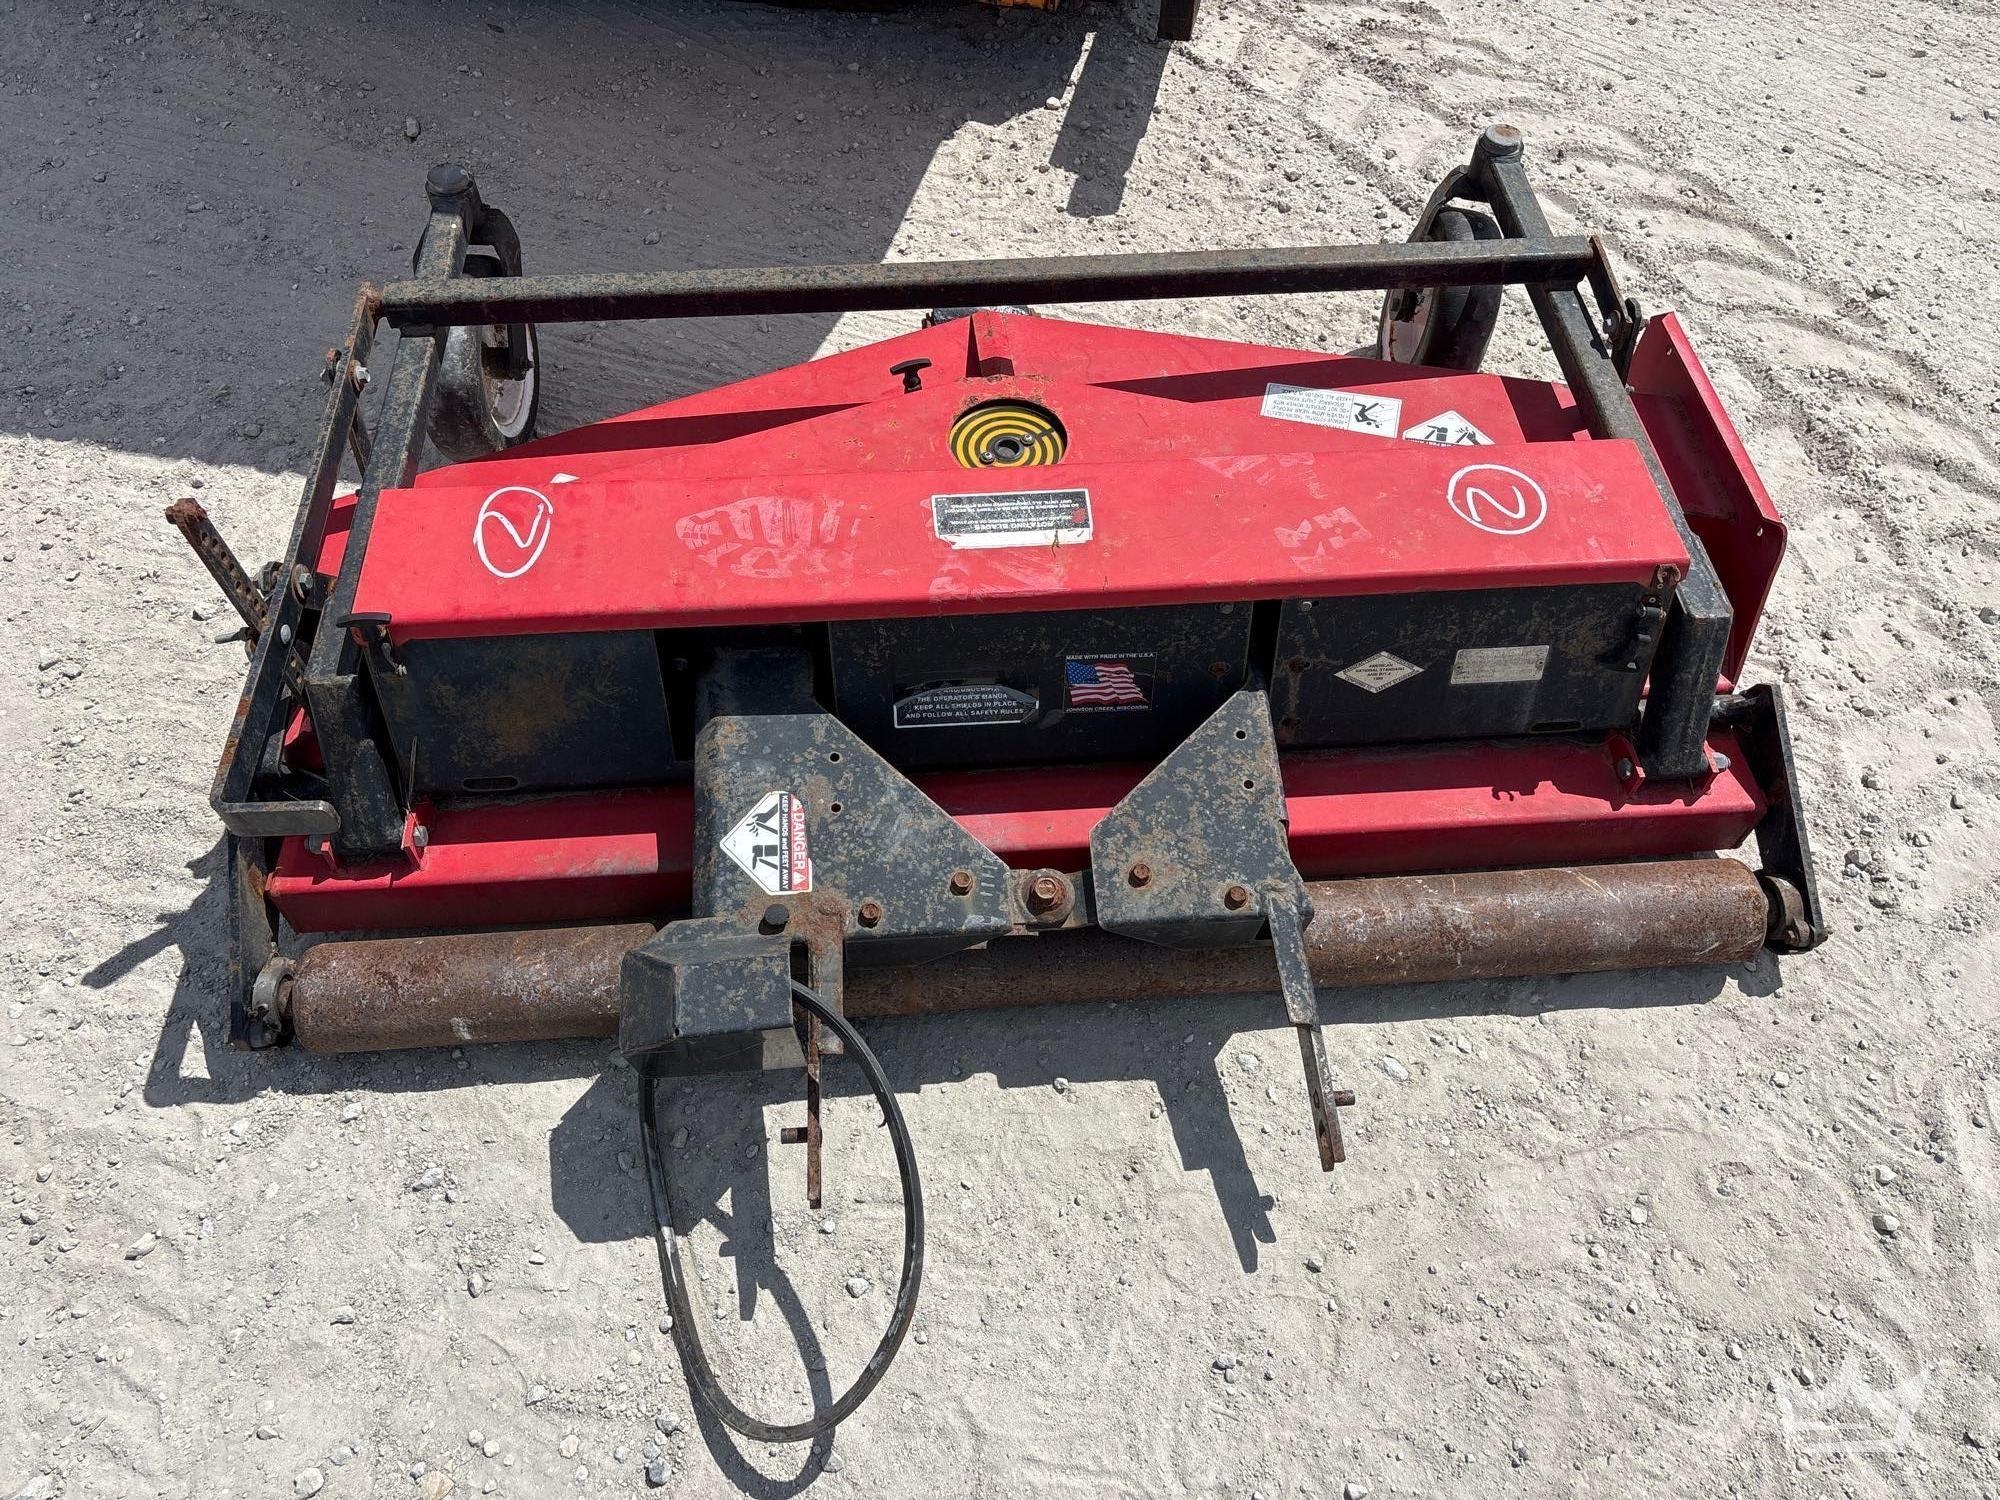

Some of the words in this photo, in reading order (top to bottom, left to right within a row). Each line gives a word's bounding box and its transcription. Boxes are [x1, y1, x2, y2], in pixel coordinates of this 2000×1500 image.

[975, 523, 1008, 531] BLADES
[1010, 520, 1054, 530] ROTATING
[794, 813, 805, 869] DANGER
